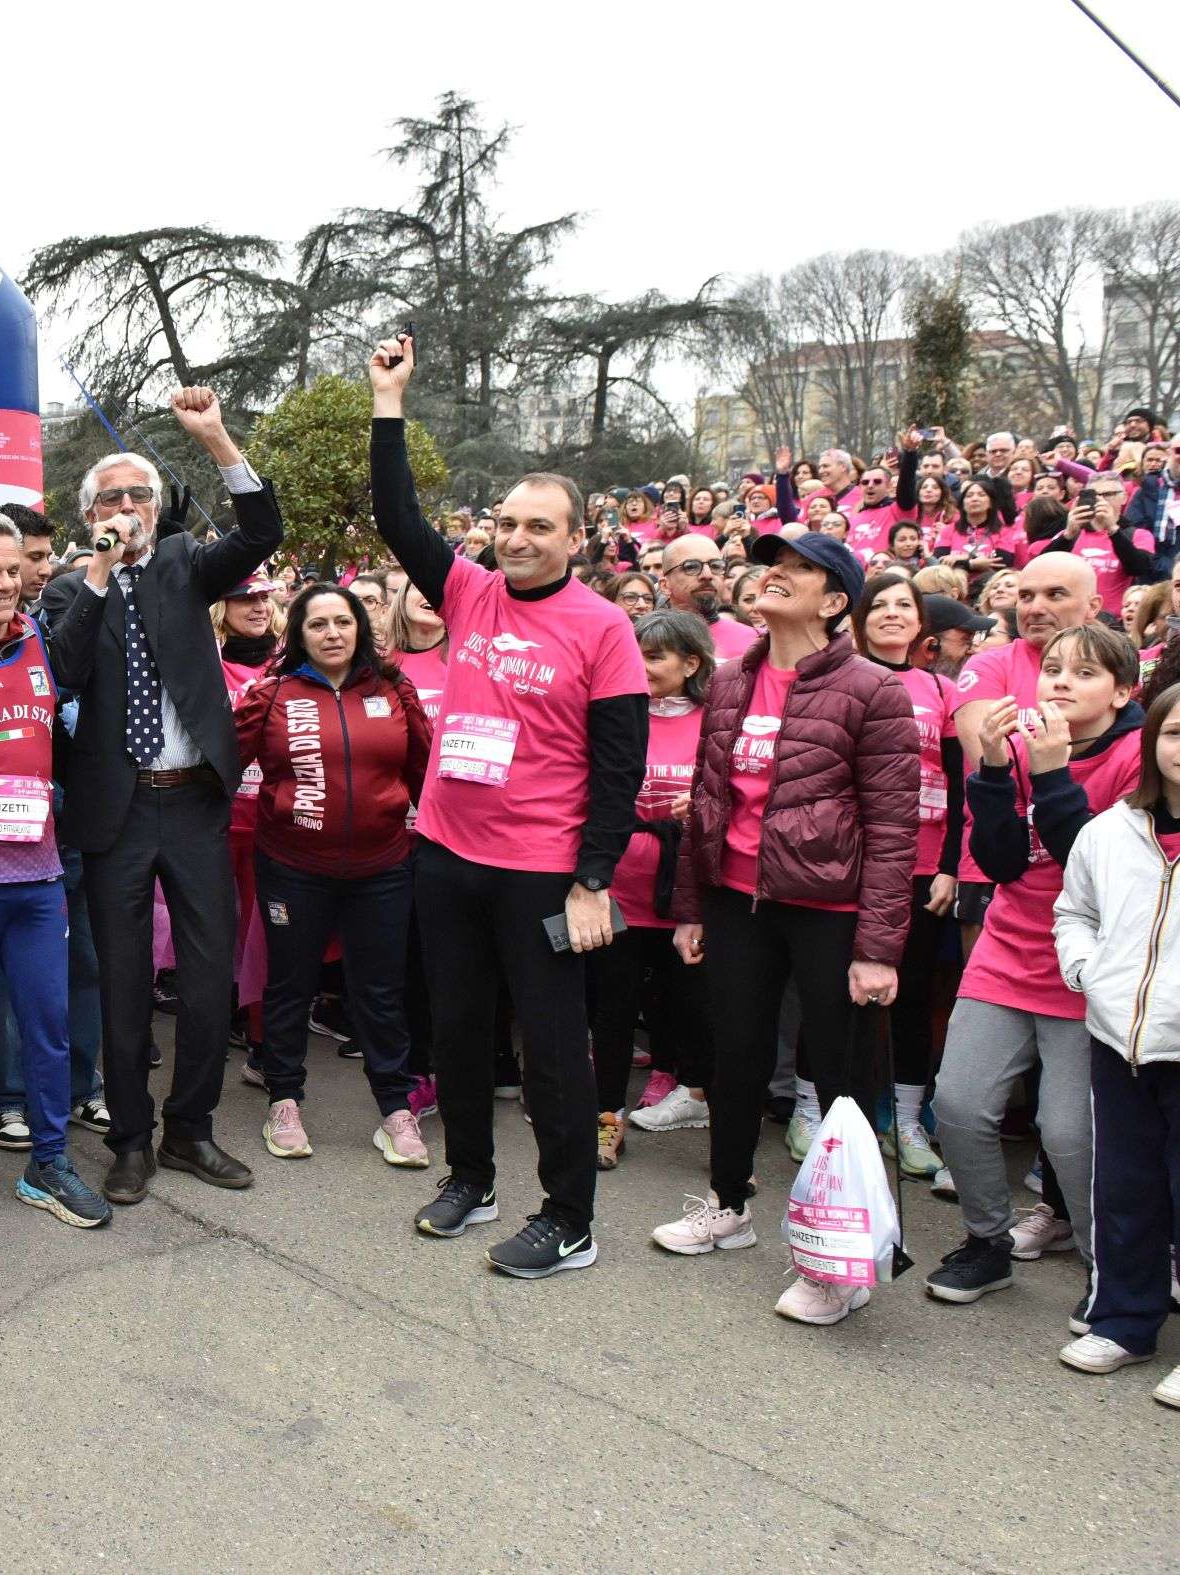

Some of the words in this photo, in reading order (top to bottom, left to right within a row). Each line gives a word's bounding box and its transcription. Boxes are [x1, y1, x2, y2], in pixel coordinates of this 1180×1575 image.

[536, 664, 556, 685] AM
[12, 704, 29, 719] DI
[285, 699, 321, 734] STATO
[288, 734, 321, 752] DI
[653, 764, 668, 777] THE
[670, 764, 694, 778] WOMA
[291, 752, 327, 812] POLIZIA
[293, 816, 323, 831] TORINO
